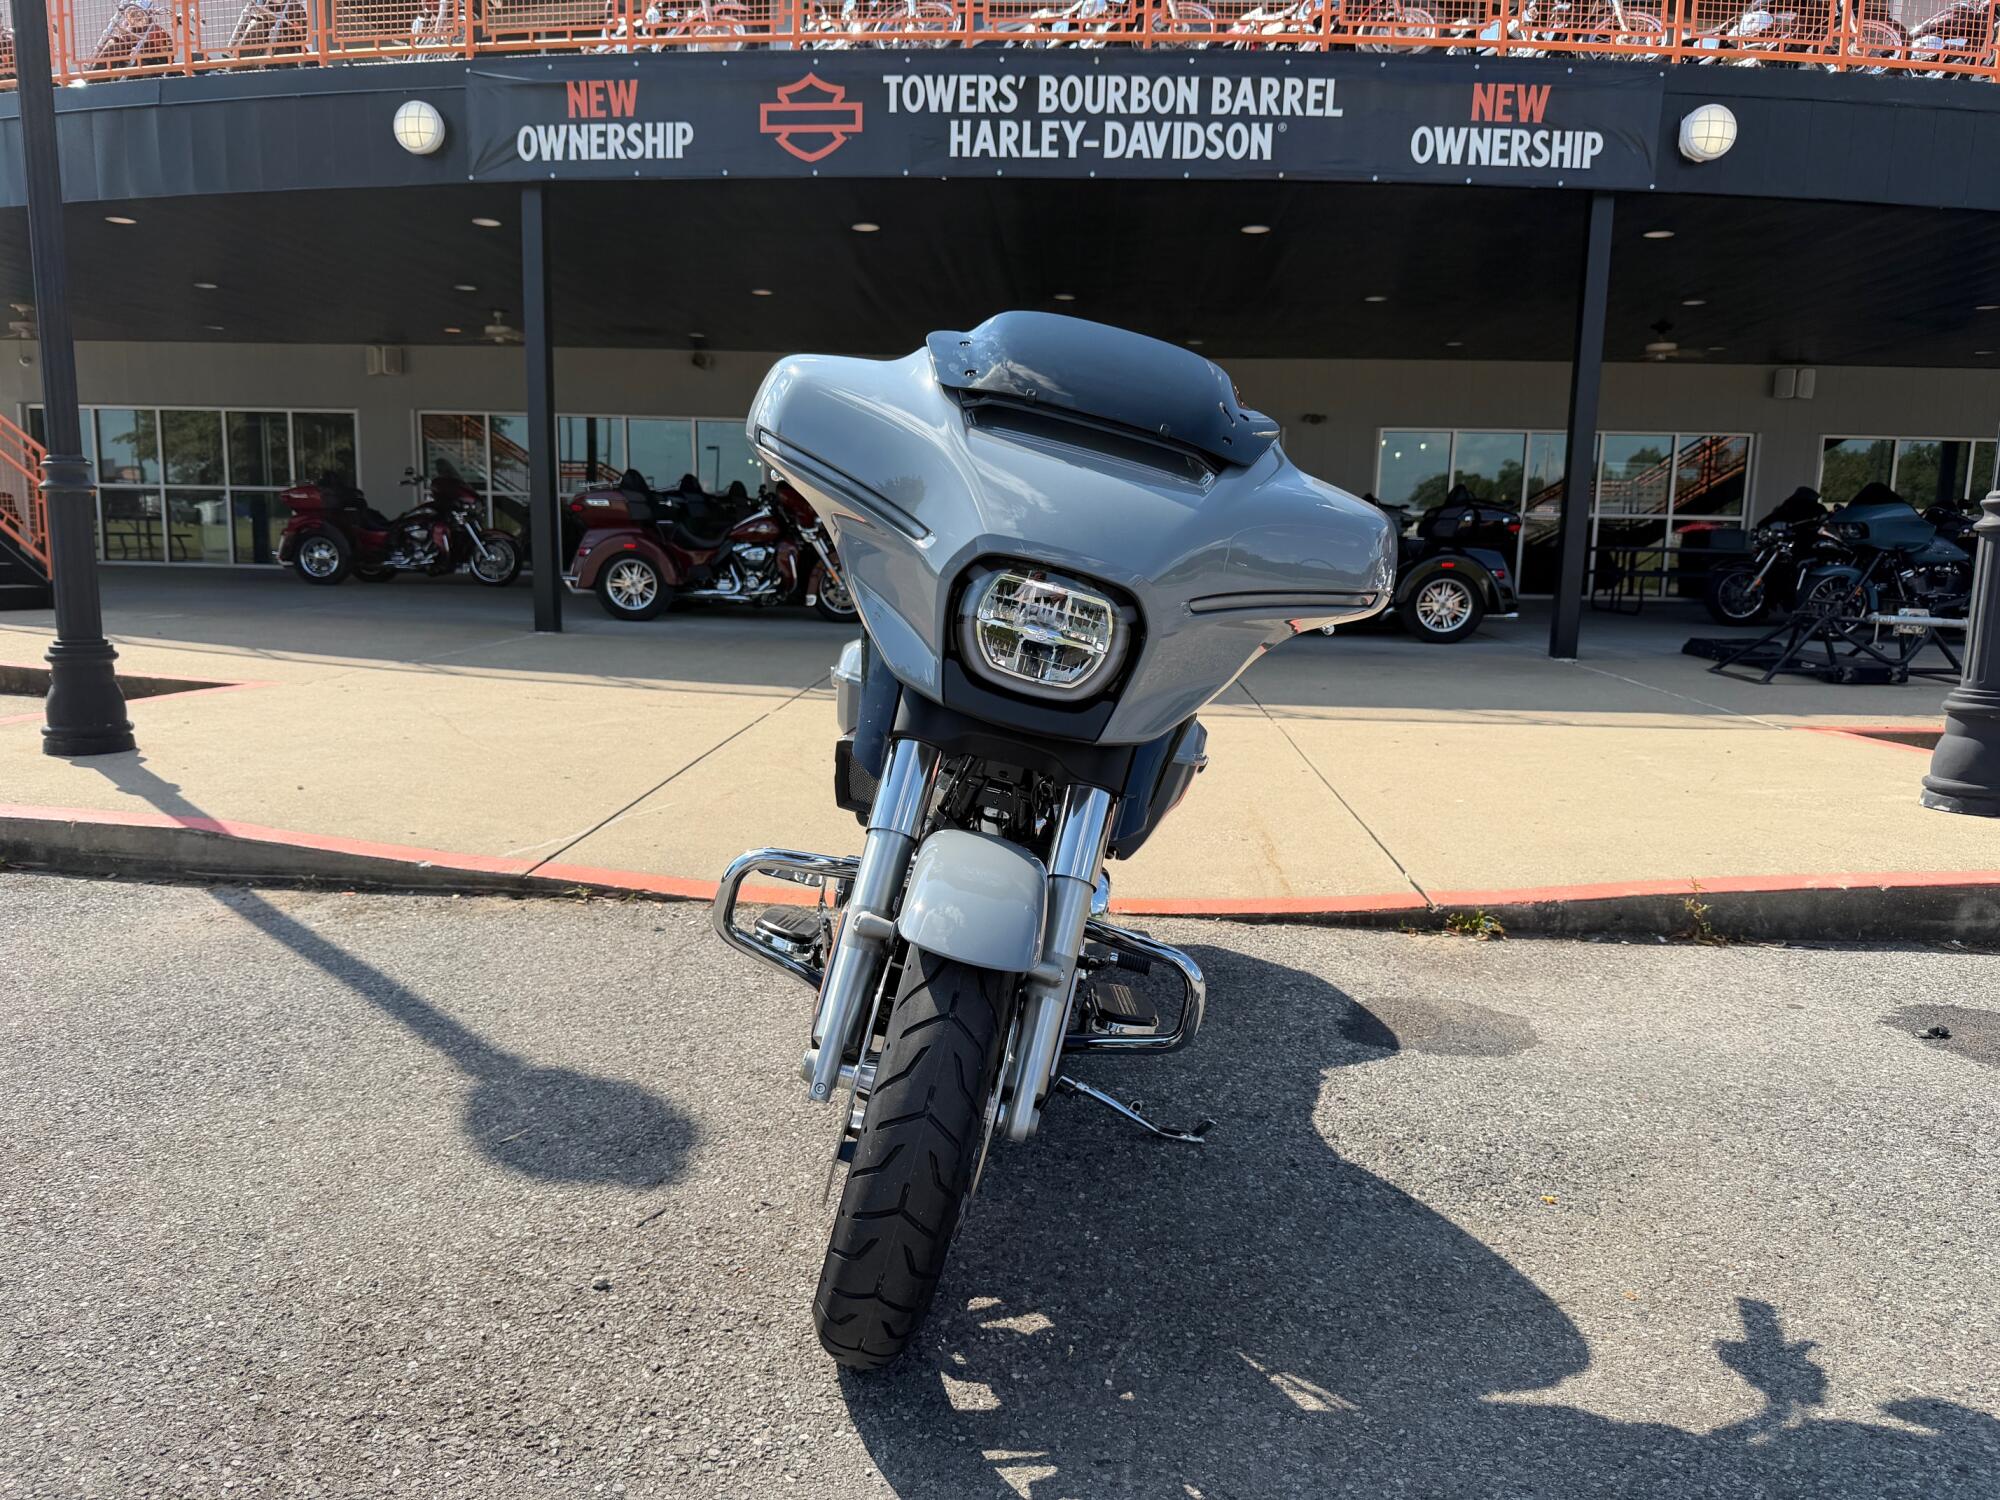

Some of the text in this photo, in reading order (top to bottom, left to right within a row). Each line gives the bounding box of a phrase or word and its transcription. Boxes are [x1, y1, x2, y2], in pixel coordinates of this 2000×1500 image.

[566, 79, 638, 119] NEW
[882, 74, 1344, 118] TOWERS' BOURBON BARREL
[1470, 82, 1552, 124] NEW
[516, 121, 694, 162] OWNERSHIP
[1410, 125, 1604, 170] OWNERSHIP
